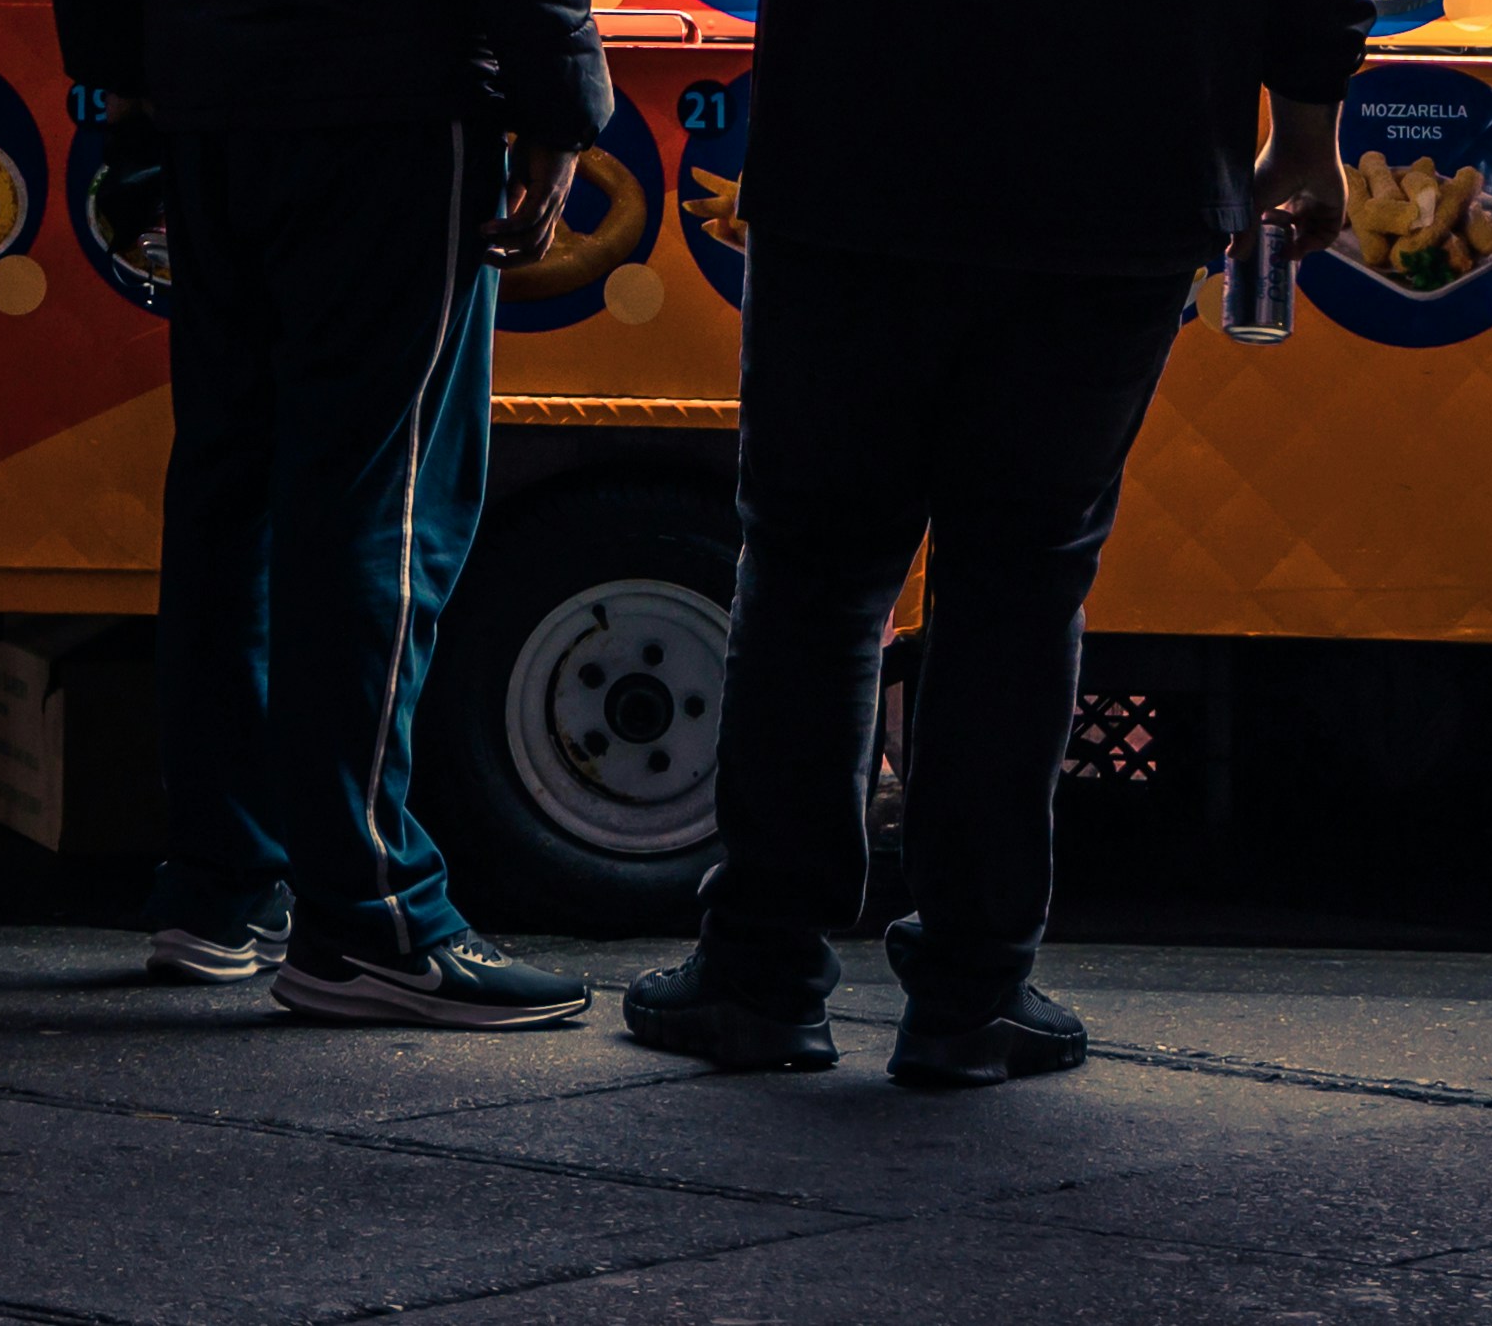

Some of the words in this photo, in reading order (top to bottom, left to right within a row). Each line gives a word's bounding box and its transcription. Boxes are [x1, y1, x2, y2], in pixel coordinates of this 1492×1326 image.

[684, 90, 728, 131] 21
[1361, 103, 1468, 118] MOZZARELLA
[1386, 124, 1443, 140] STICKS
